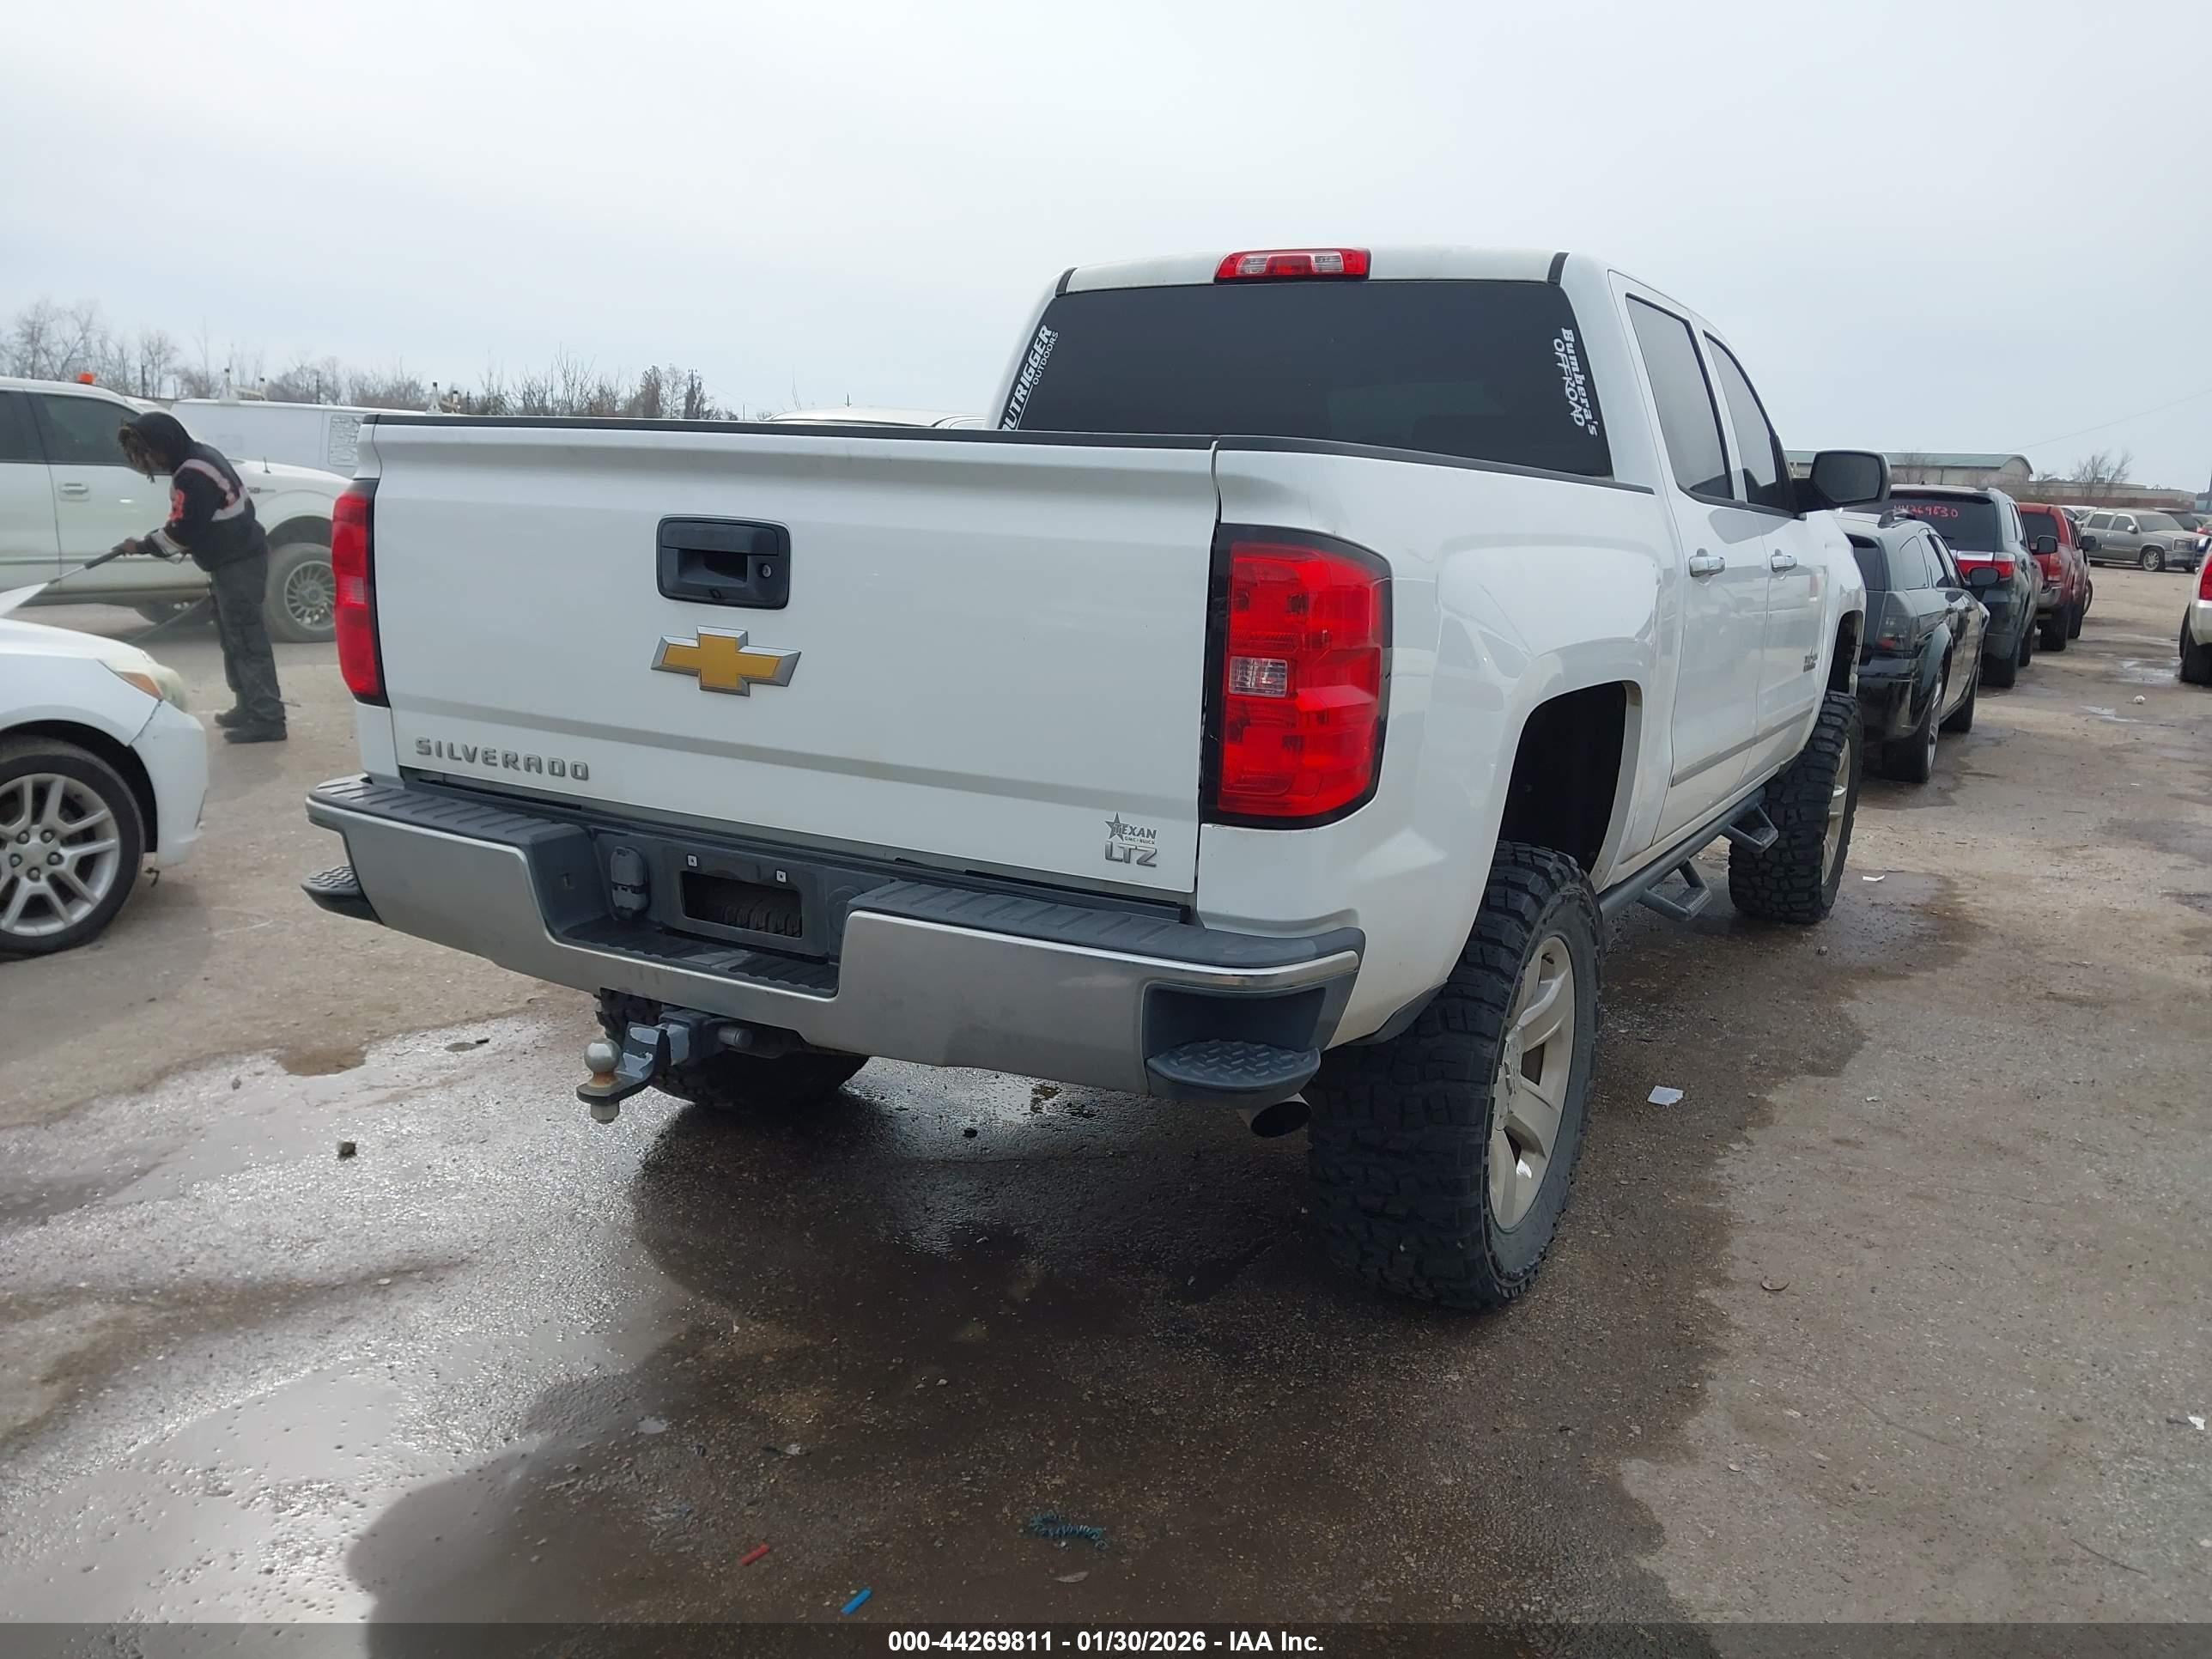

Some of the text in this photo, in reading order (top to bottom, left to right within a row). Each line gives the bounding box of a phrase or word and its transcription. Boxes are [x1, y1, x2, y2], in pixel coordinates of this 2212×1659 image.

[1032, 331, 1059, 386] OUTDOORS
[1553, 337, 1585, 427] OFFROAD
[1561, 327, 1599, 436] Bumbera's
[415, 737, 589, 781] SILVERADO
[1104, 841, 1158, 868] LTZ
[1113, 823, 1158, 840] TEXAN
